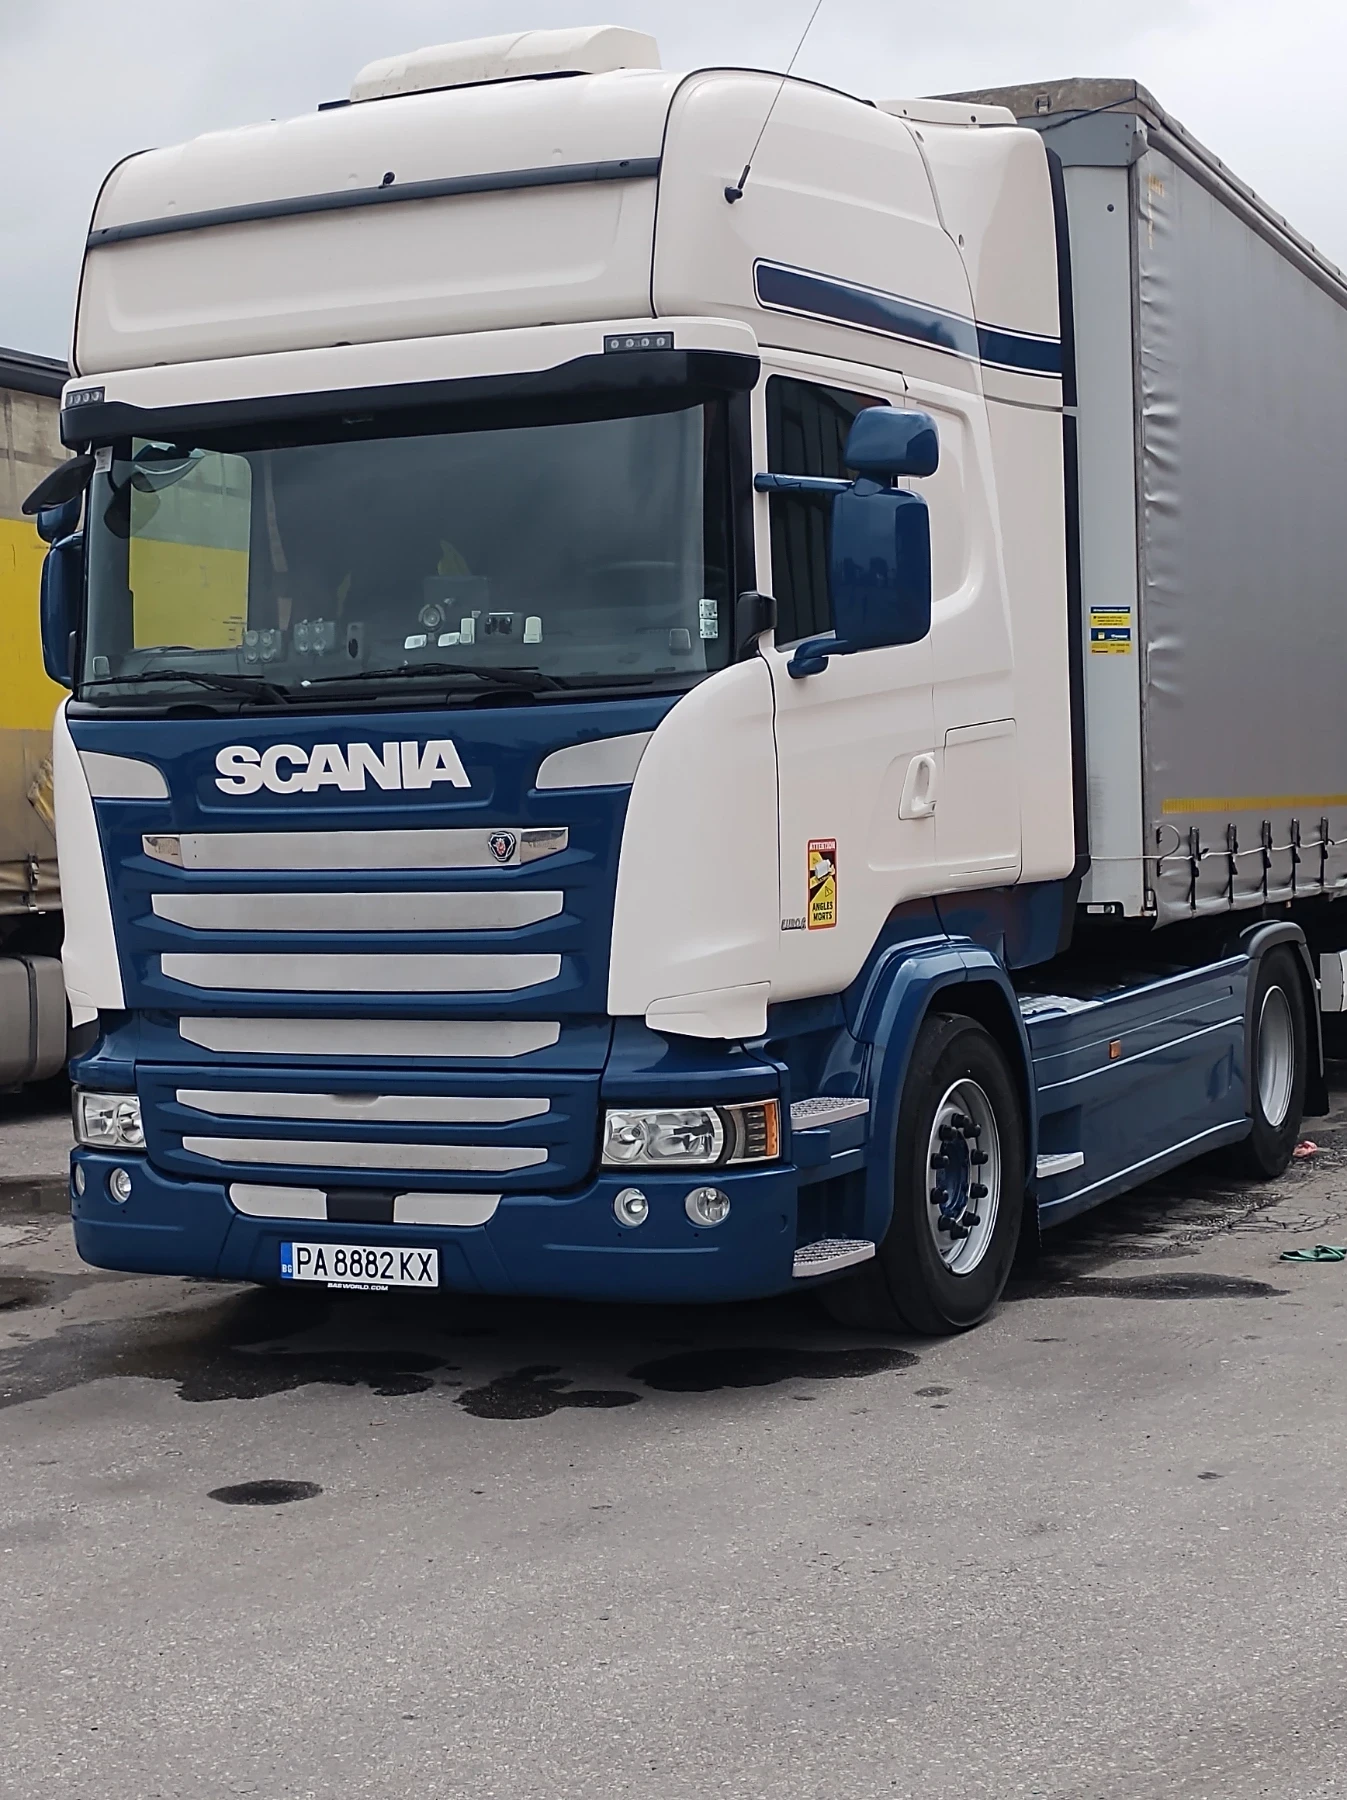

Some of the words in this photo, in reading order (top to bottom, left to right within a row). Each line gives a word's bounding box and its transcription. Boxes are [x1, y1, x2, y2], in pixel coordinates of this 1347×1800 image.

[215, 739, 472, 795] SCANIA
[812, 902, 833, 911] ANGLES
[813, 911, 833, 921] MORTS
[281, 1264, 293, 1274] BG
[296, 1247, 328, 1276] PA
[334, 1248, 394, 1280] 8882
[400, 1251, 433, 1282] KX
